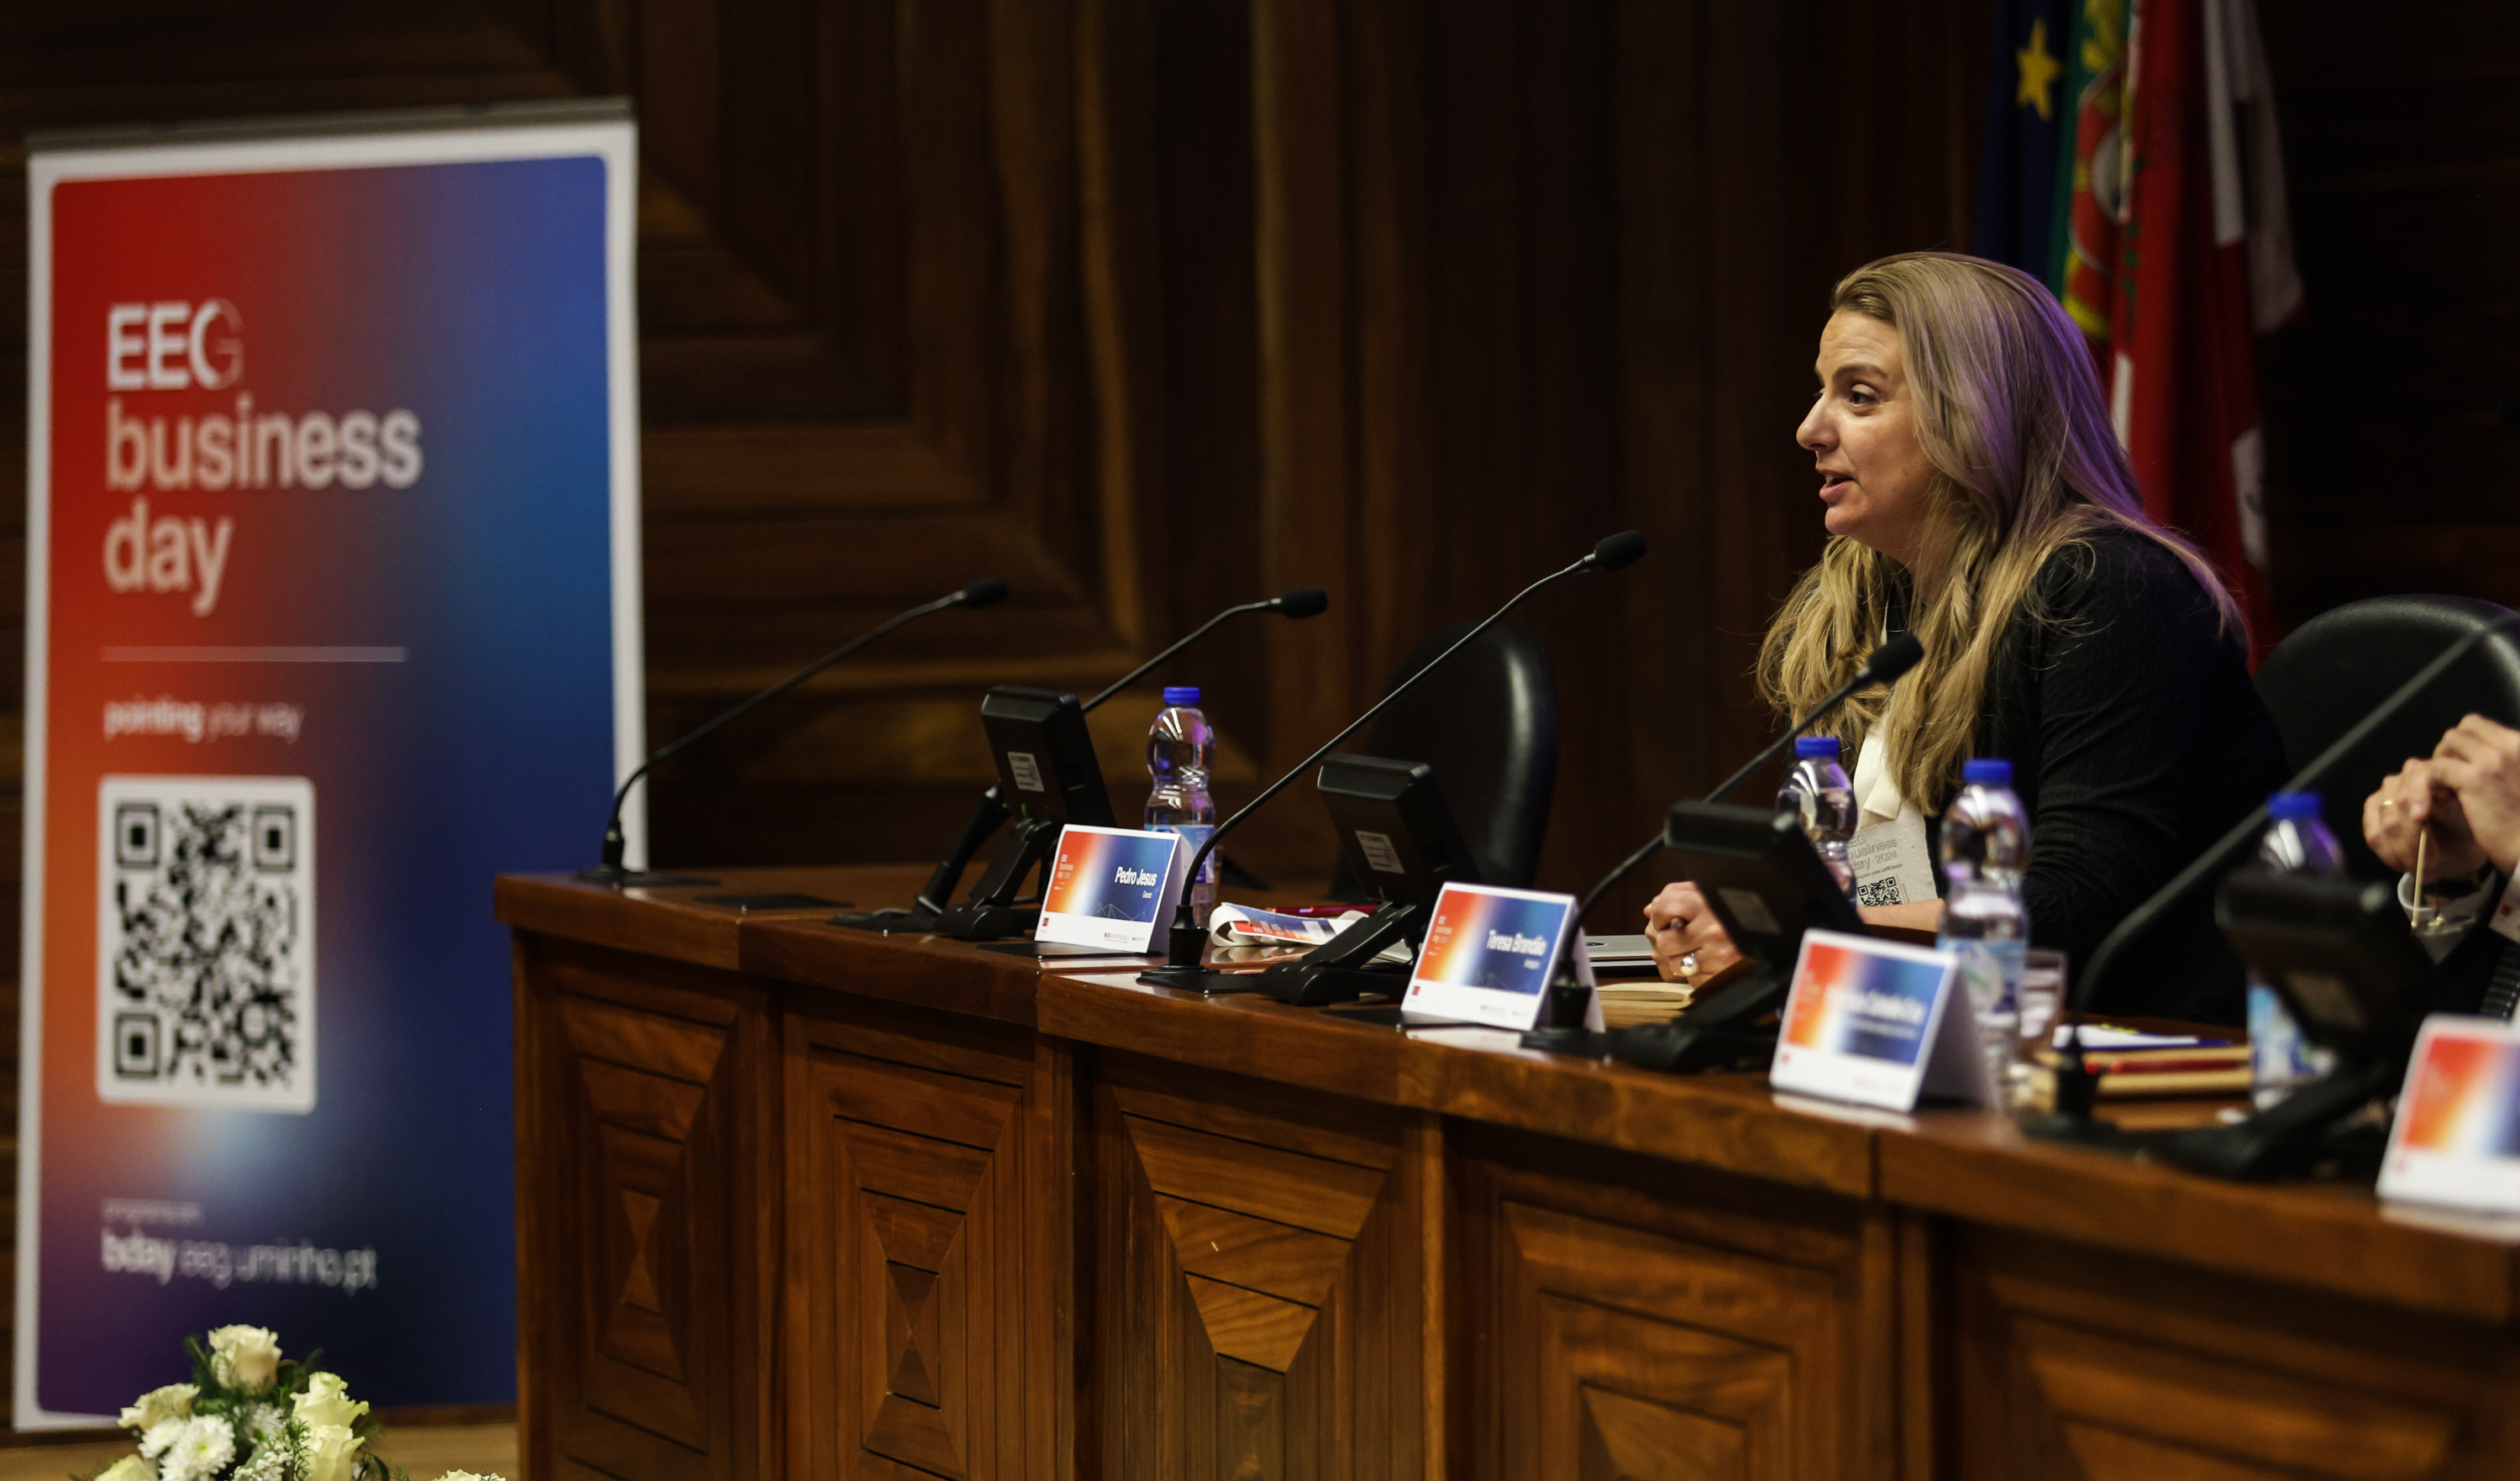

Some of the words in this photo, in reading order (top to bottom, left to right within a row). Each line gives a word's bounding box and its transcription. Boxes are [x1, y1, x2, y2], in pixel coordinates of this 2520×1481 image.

[106, 300, 244, 391] EEG
[106, 392, 423, 491] business
[102, 496, 234, 617] day
[1114, 866, 1137, 885] Pedro
[1136, 869, 1158, 887] Jesus
[1486, 929, 1514, 953] Teresa
[1511, 932, 1547, 957] Brandão
